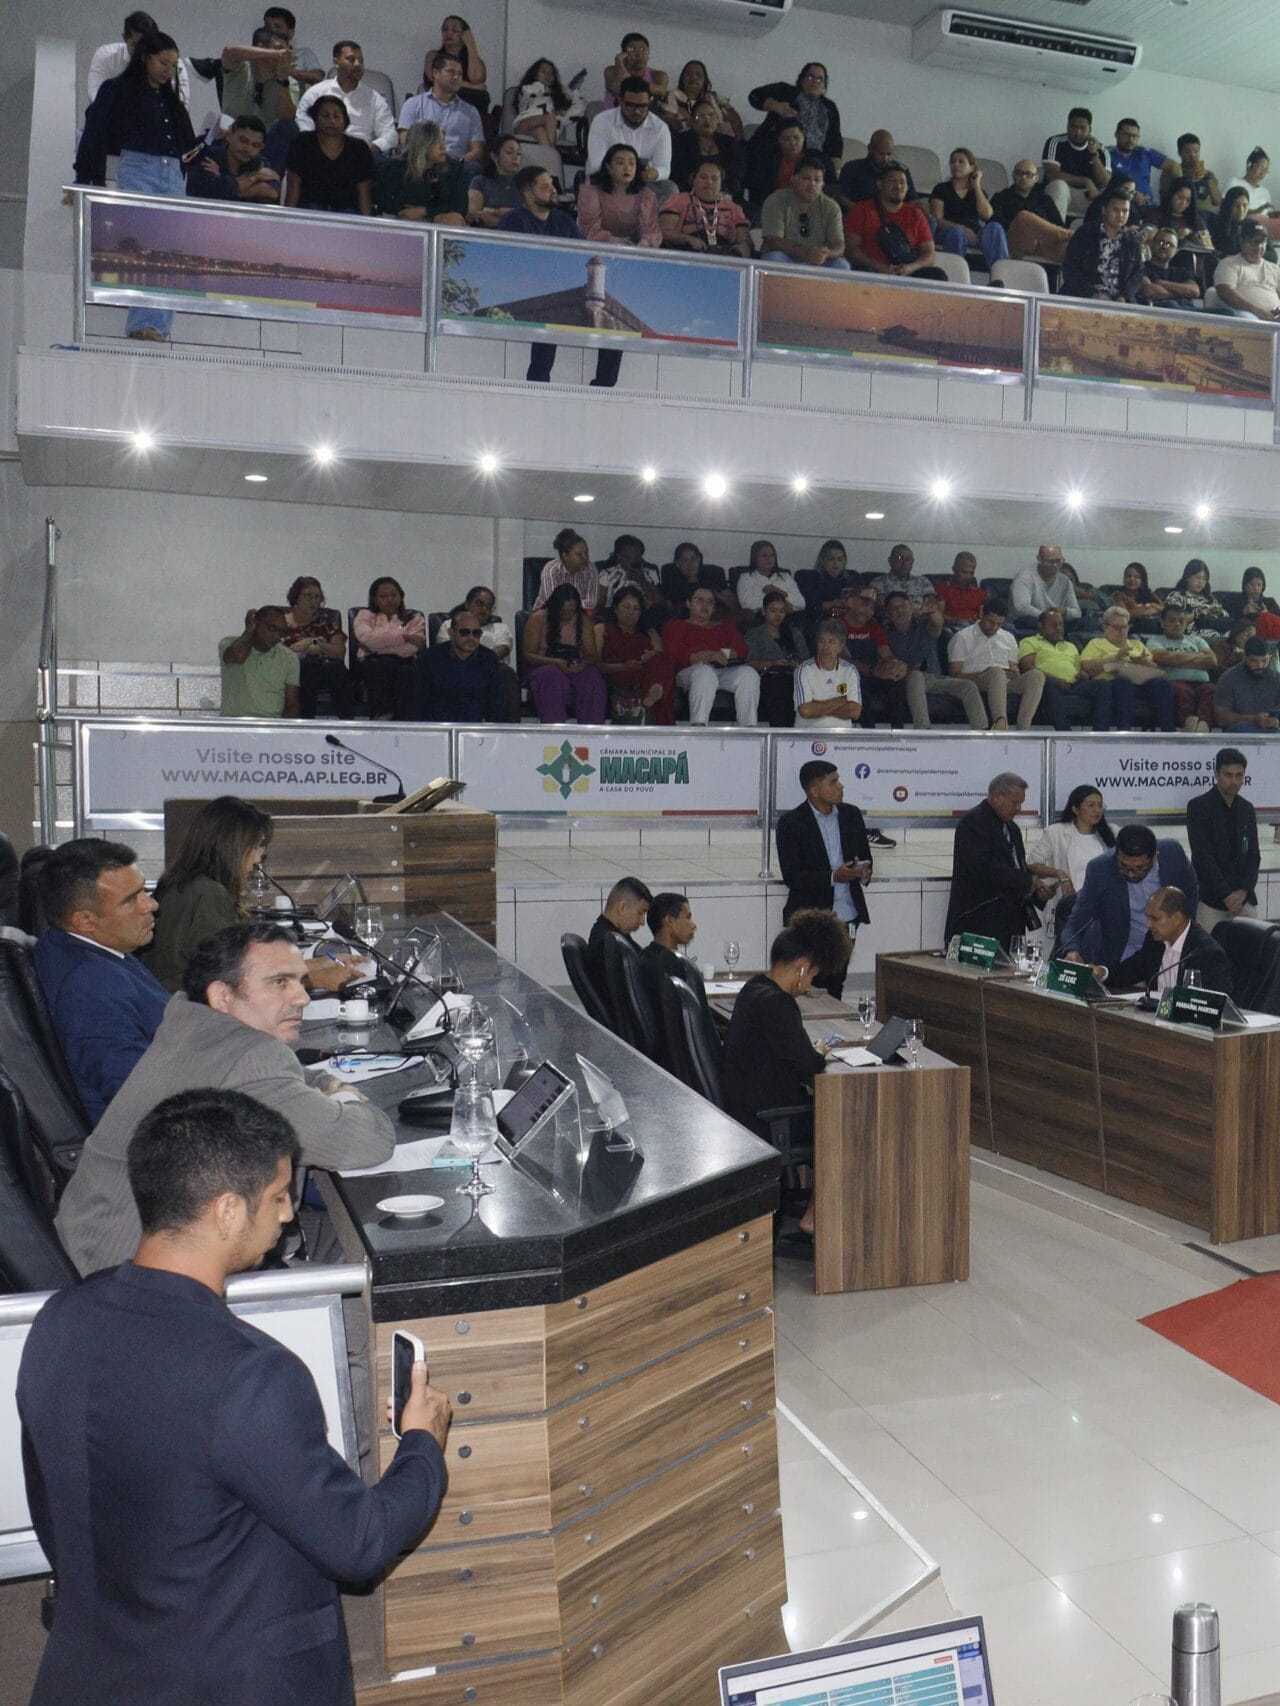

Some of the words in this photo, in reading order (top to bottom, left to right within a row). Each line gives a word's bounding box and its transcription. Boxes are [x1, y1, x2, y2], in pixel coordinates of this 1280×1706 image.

[195, 748, 252, 765] Visite
[258, 751, 316, 765] nosso
[321, 749, 356, 766] site
[599, 747, 628, 756] CÂMARA
[629, 748, 667, 756] MUNICIPAL
[599, 750, 690, 785] MACAPÁ
[1119, 758, 1159, 772] Visite
[1162, 760, 1202, 772] nosso
[161, 769, 388, 785] WWW.MACAPA.AP.LEG.BR
